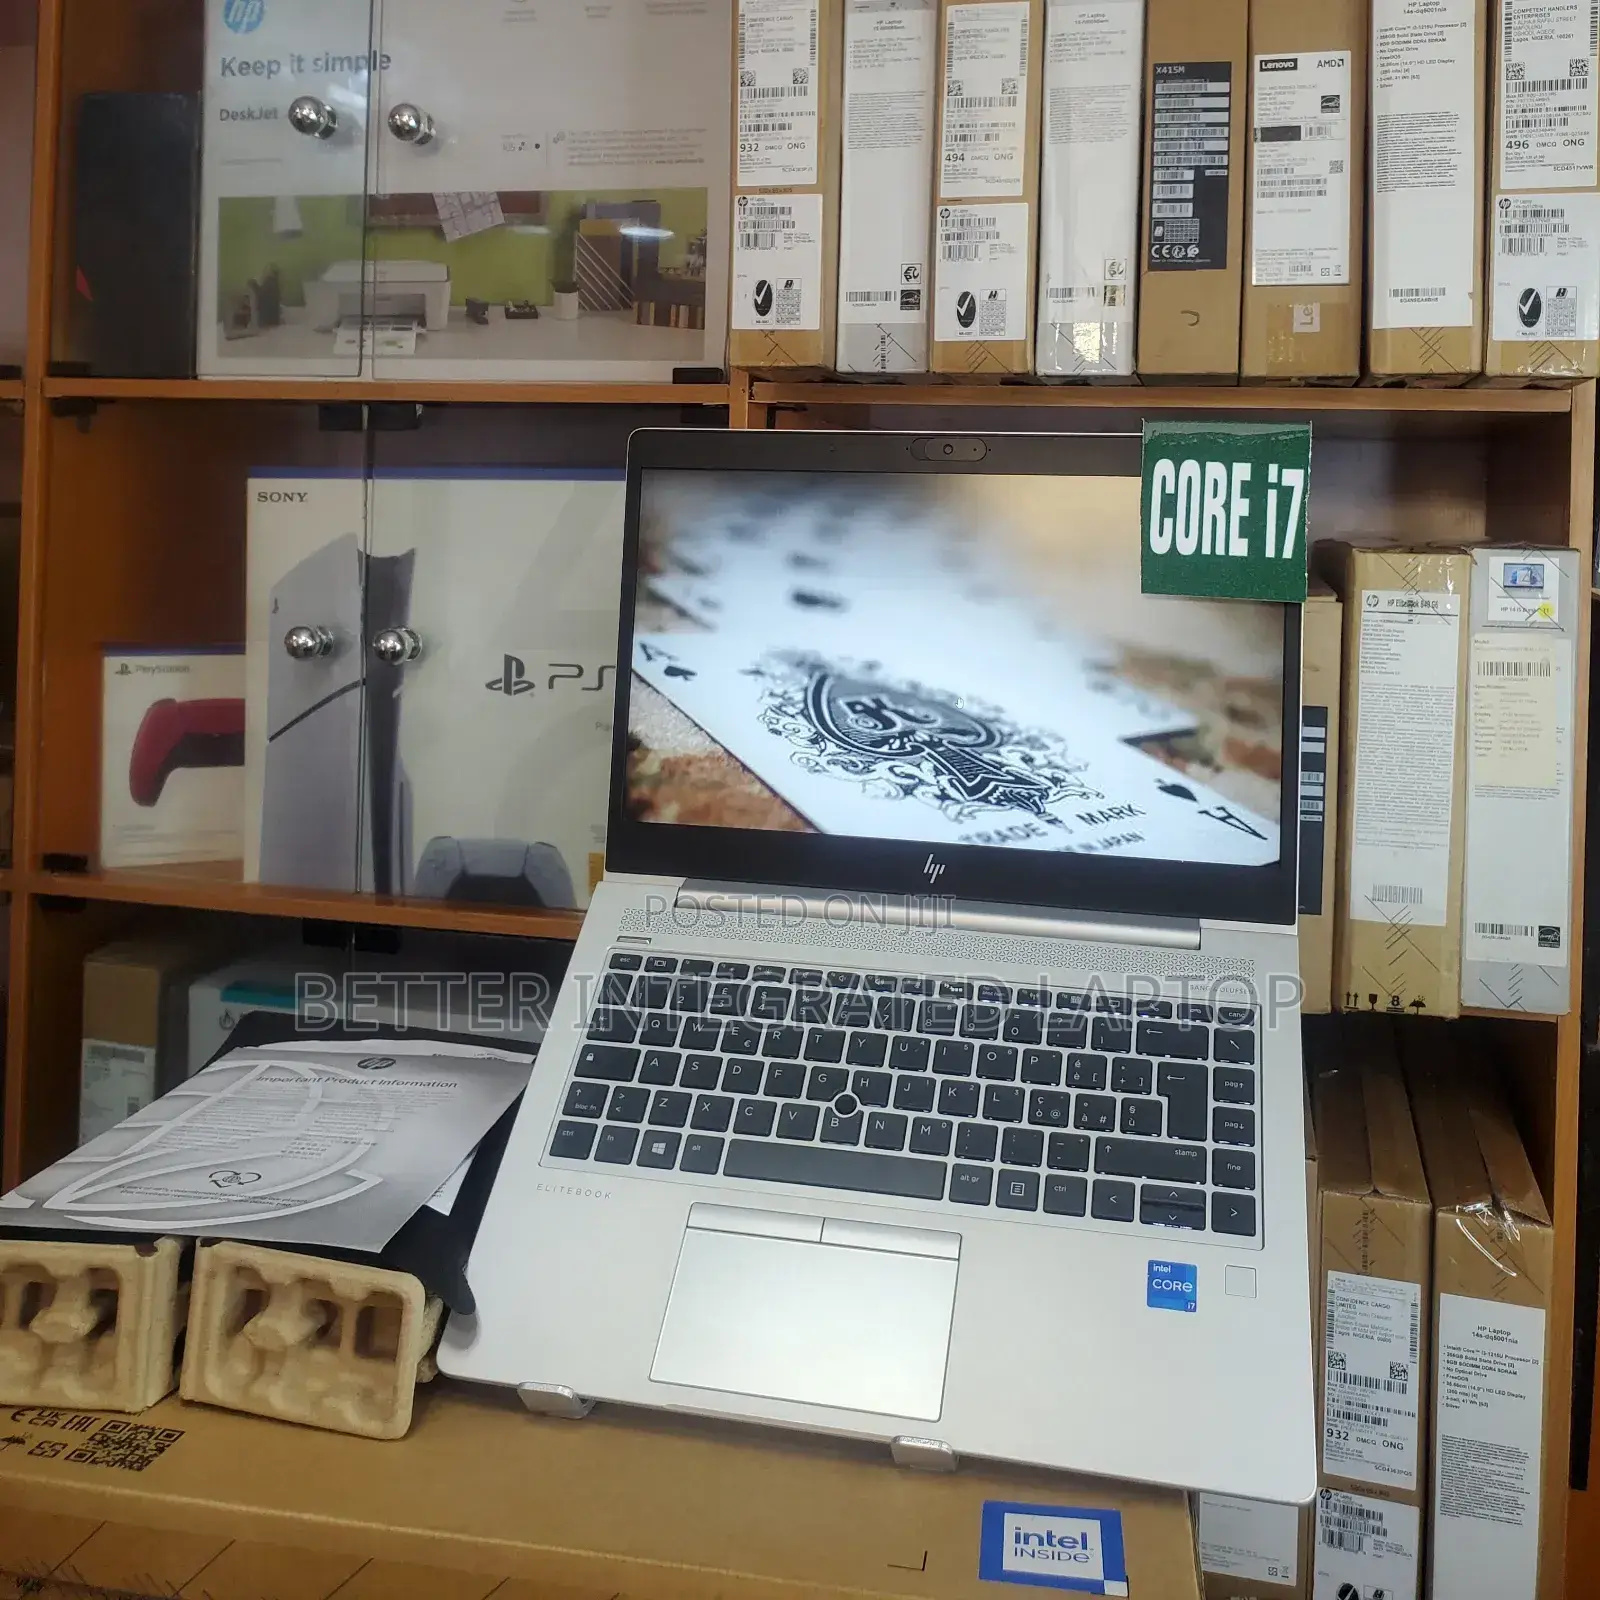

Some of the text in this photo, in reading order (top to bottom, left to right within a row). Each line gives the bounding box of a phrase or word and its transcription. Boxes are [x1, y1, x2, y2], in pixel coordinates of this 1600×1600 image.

[221, 50, 392, 79] Keep it simple
[1262, 59, 1337, 69] Lenovo AMD
[1156, 66, 1186, 74] X415M
[219, 107, 278, 122] DeskJet
[740, 143, 759, 152] 932
[1505, 140, 1530, 150] 496
[1562, 138, 1585, 147] ONG
[944, 153, 965, 162] 494
[257, 491, 308, 502] SONY
[1150, 458, 1306, 560] CORE i7
[1076, 803, 1146, 826] MARK
[1198, 806, 1268, 841] A
[959, 821, 1048, 843] TRADE
[651, 1019, 661, 1029] Q
[692, 1023, 705, 1032] W
[731, 1026, 740, 1036] E
[772, 1030, 782, 1040] R
[814, 1034, 823, 1044] T
[857, 1038, 866, 1048] Y
[900, 1042, 909, 1052] U
[650, 1057, 659, 1067] A
[1030, 1056, 1039, 1065] P
[691, 1061, 700, 1071] S
[732, 1065, 742, 1075] D
[774, 1069, 783, 1078] F
[818, 1073, 827, 1083] G
[256, 1076, 458, 1090] Important Product Information
[860, 1078, 870, 1087] H
[903, 1082, 911, 1092] J
[948, 1087, 958, 1097] K
[992, 1092, 1000, 1102] L
[659, 1098, 669, 1108] Z
[701, 1102, 712, 1112] X
[744, 1106, 754, 1116] C
[788, 1110, 798, 1120] V
[830, 1118, 840, 1127] B
[875, 1120, 885, 1130] N
[920, 1124, 931, 1136] M
[1174, 1148, 1198, 1158] stamp
[1226, 1163, 1241, 1172] fine
[536, 1183, 612, 1200] ELITEBOOK
[1153, 1264, 1171, 1273] intel
[1488, 1326, 1512, 1336] Laptop
[1326, 1428, 1350, 1441] 932
[1382, 1440, 1404, 1450] ONG
[1014, 1526, 1088, 1550] intel
